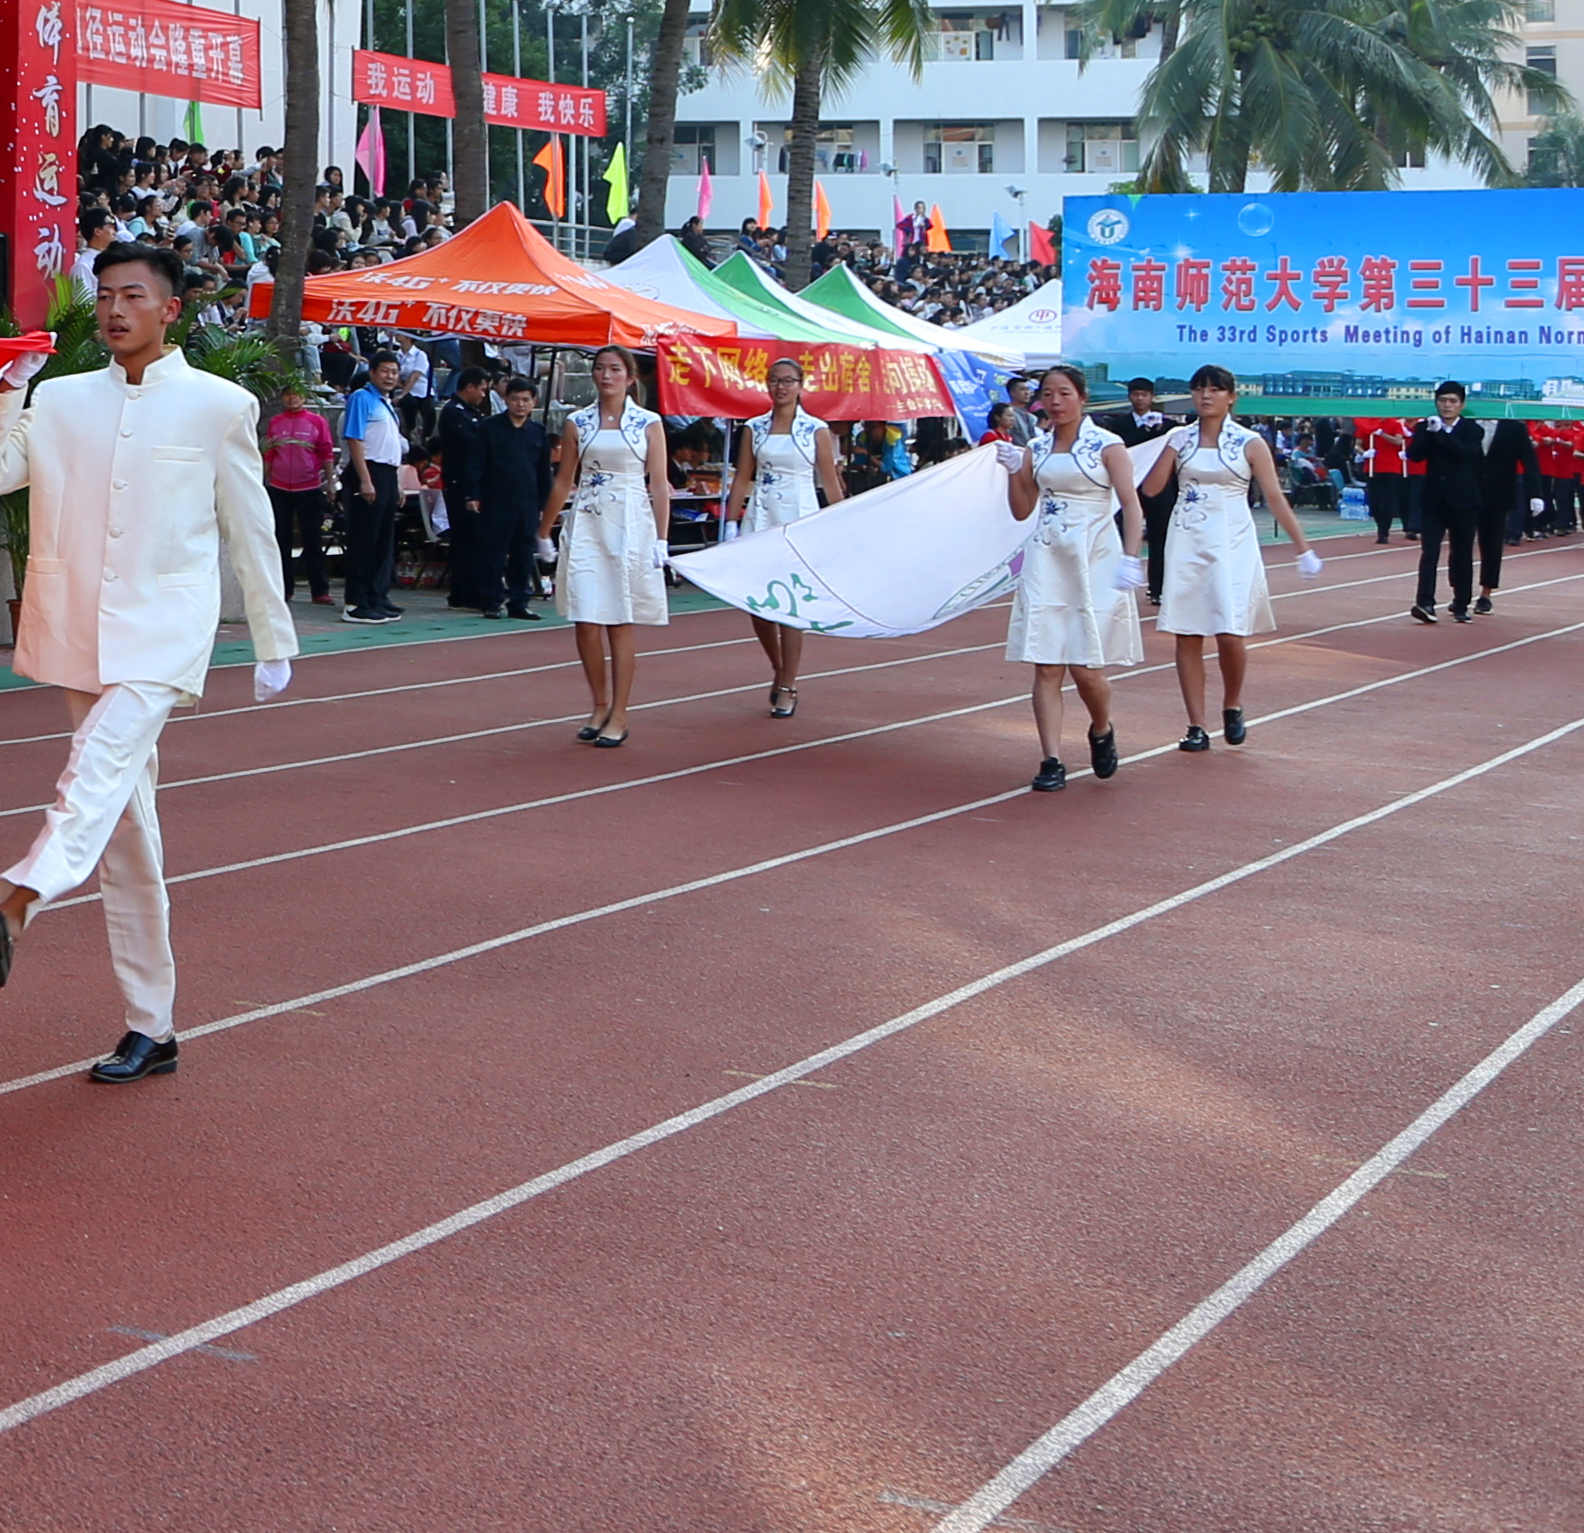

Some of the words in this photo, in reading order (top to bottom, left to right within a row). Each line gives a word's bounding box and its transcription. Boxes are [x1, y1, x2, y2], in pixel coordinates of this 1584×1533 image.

[77, 5, 244, 85] 径运动会隆重开幕
[367, 62, 435, 104] 我运动
[538, 91, 595, 128] 我快乐
[1086, 254, 1584, 313] 海南师范大学第三十三届
[423, 301, 528, 338] 不仅更快
[1176, 325, 1209, 343] The
[1217, 325, 1258, 343] 33rd
[1266, 325, 1329, 347] Sports
[1344, 325, 1423, 348] Meeting
[1432, 325, 1452, 344] of
[1460, 325, 1529, 345] Hainan
[667, 340, 770, 393] 走下网络
